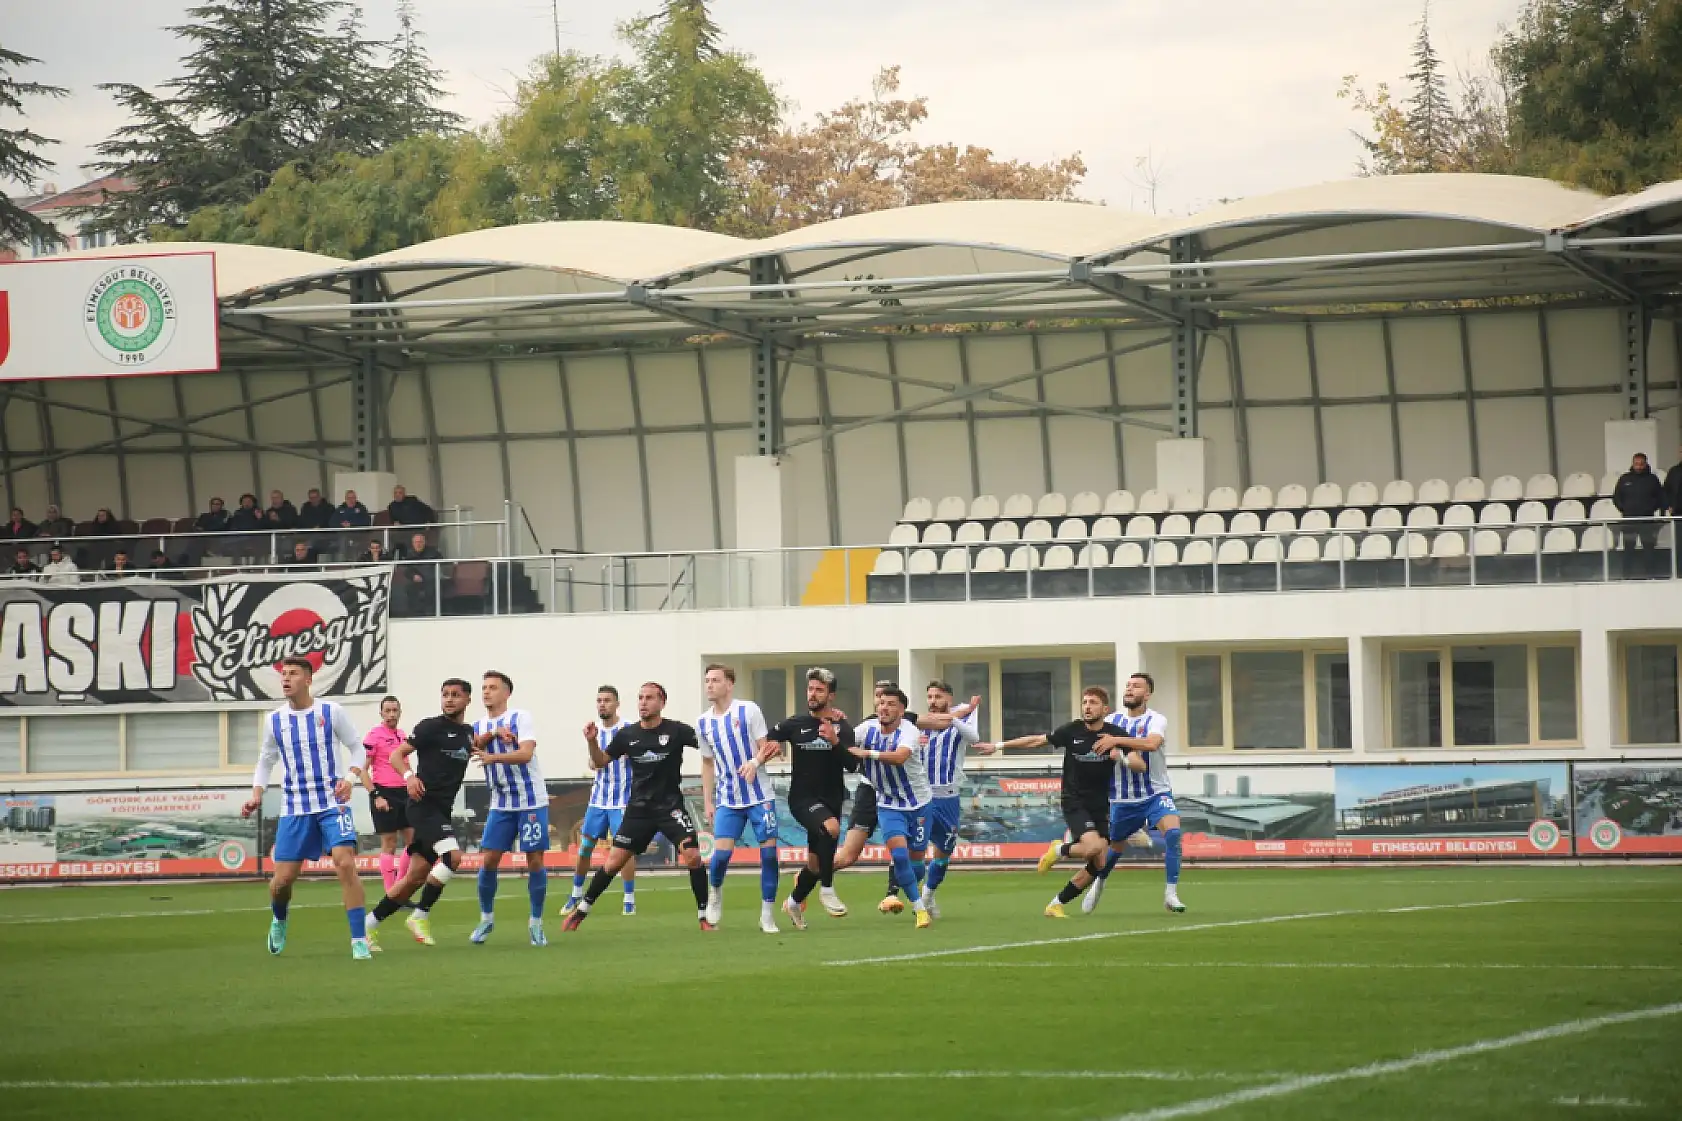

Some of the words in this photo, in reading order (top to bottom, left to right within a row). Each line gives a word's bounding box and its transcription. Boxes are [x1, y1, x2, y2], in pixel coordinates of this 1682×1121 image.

[131, 269, 176, 319] BELEDİYESİ
[1, 601, 177, 700] AŞKI
[522, 822, 542, 841] 23
[916, 826, 925, 843] 3
[59, 861, 160, 875] BELEDİYESİ
